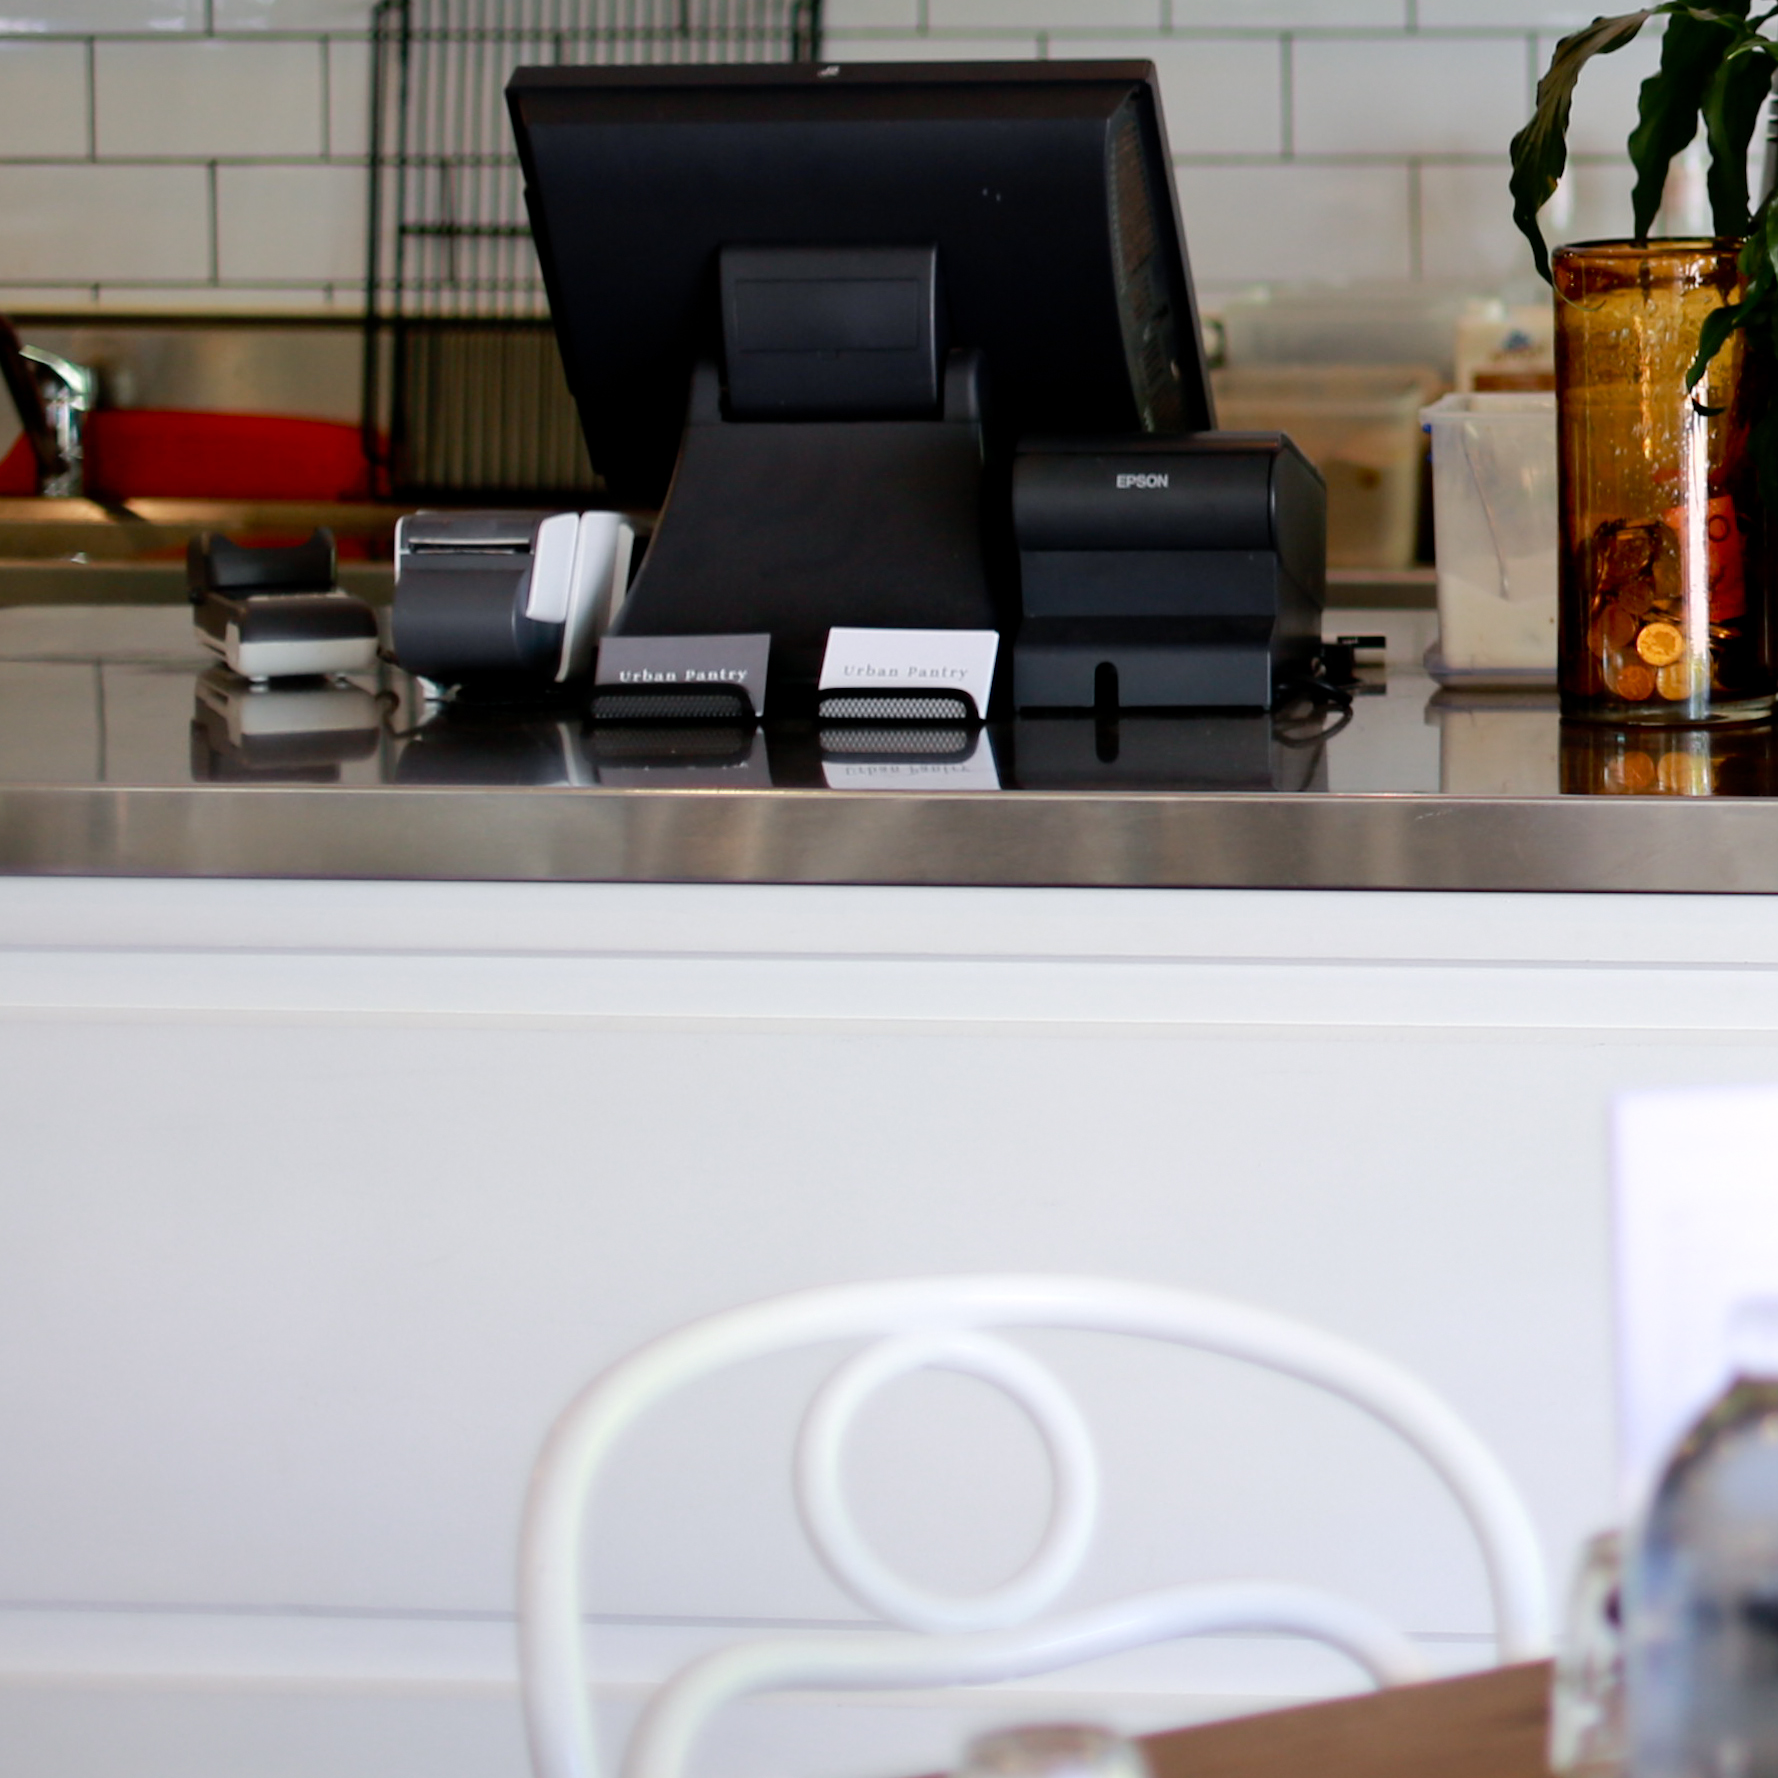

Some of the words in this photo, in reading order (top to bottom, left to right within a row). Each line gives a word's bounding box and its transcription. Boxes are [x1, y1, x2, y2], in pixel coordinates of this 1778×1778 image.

[1116, 474, 1168, 488] EPSON
[619, 668, 676, 683] Urban
[685, 668, 749, 682] Pantry
[843, 664, 898, 678] Urban
[907, 665, 968, 679] Pantry
